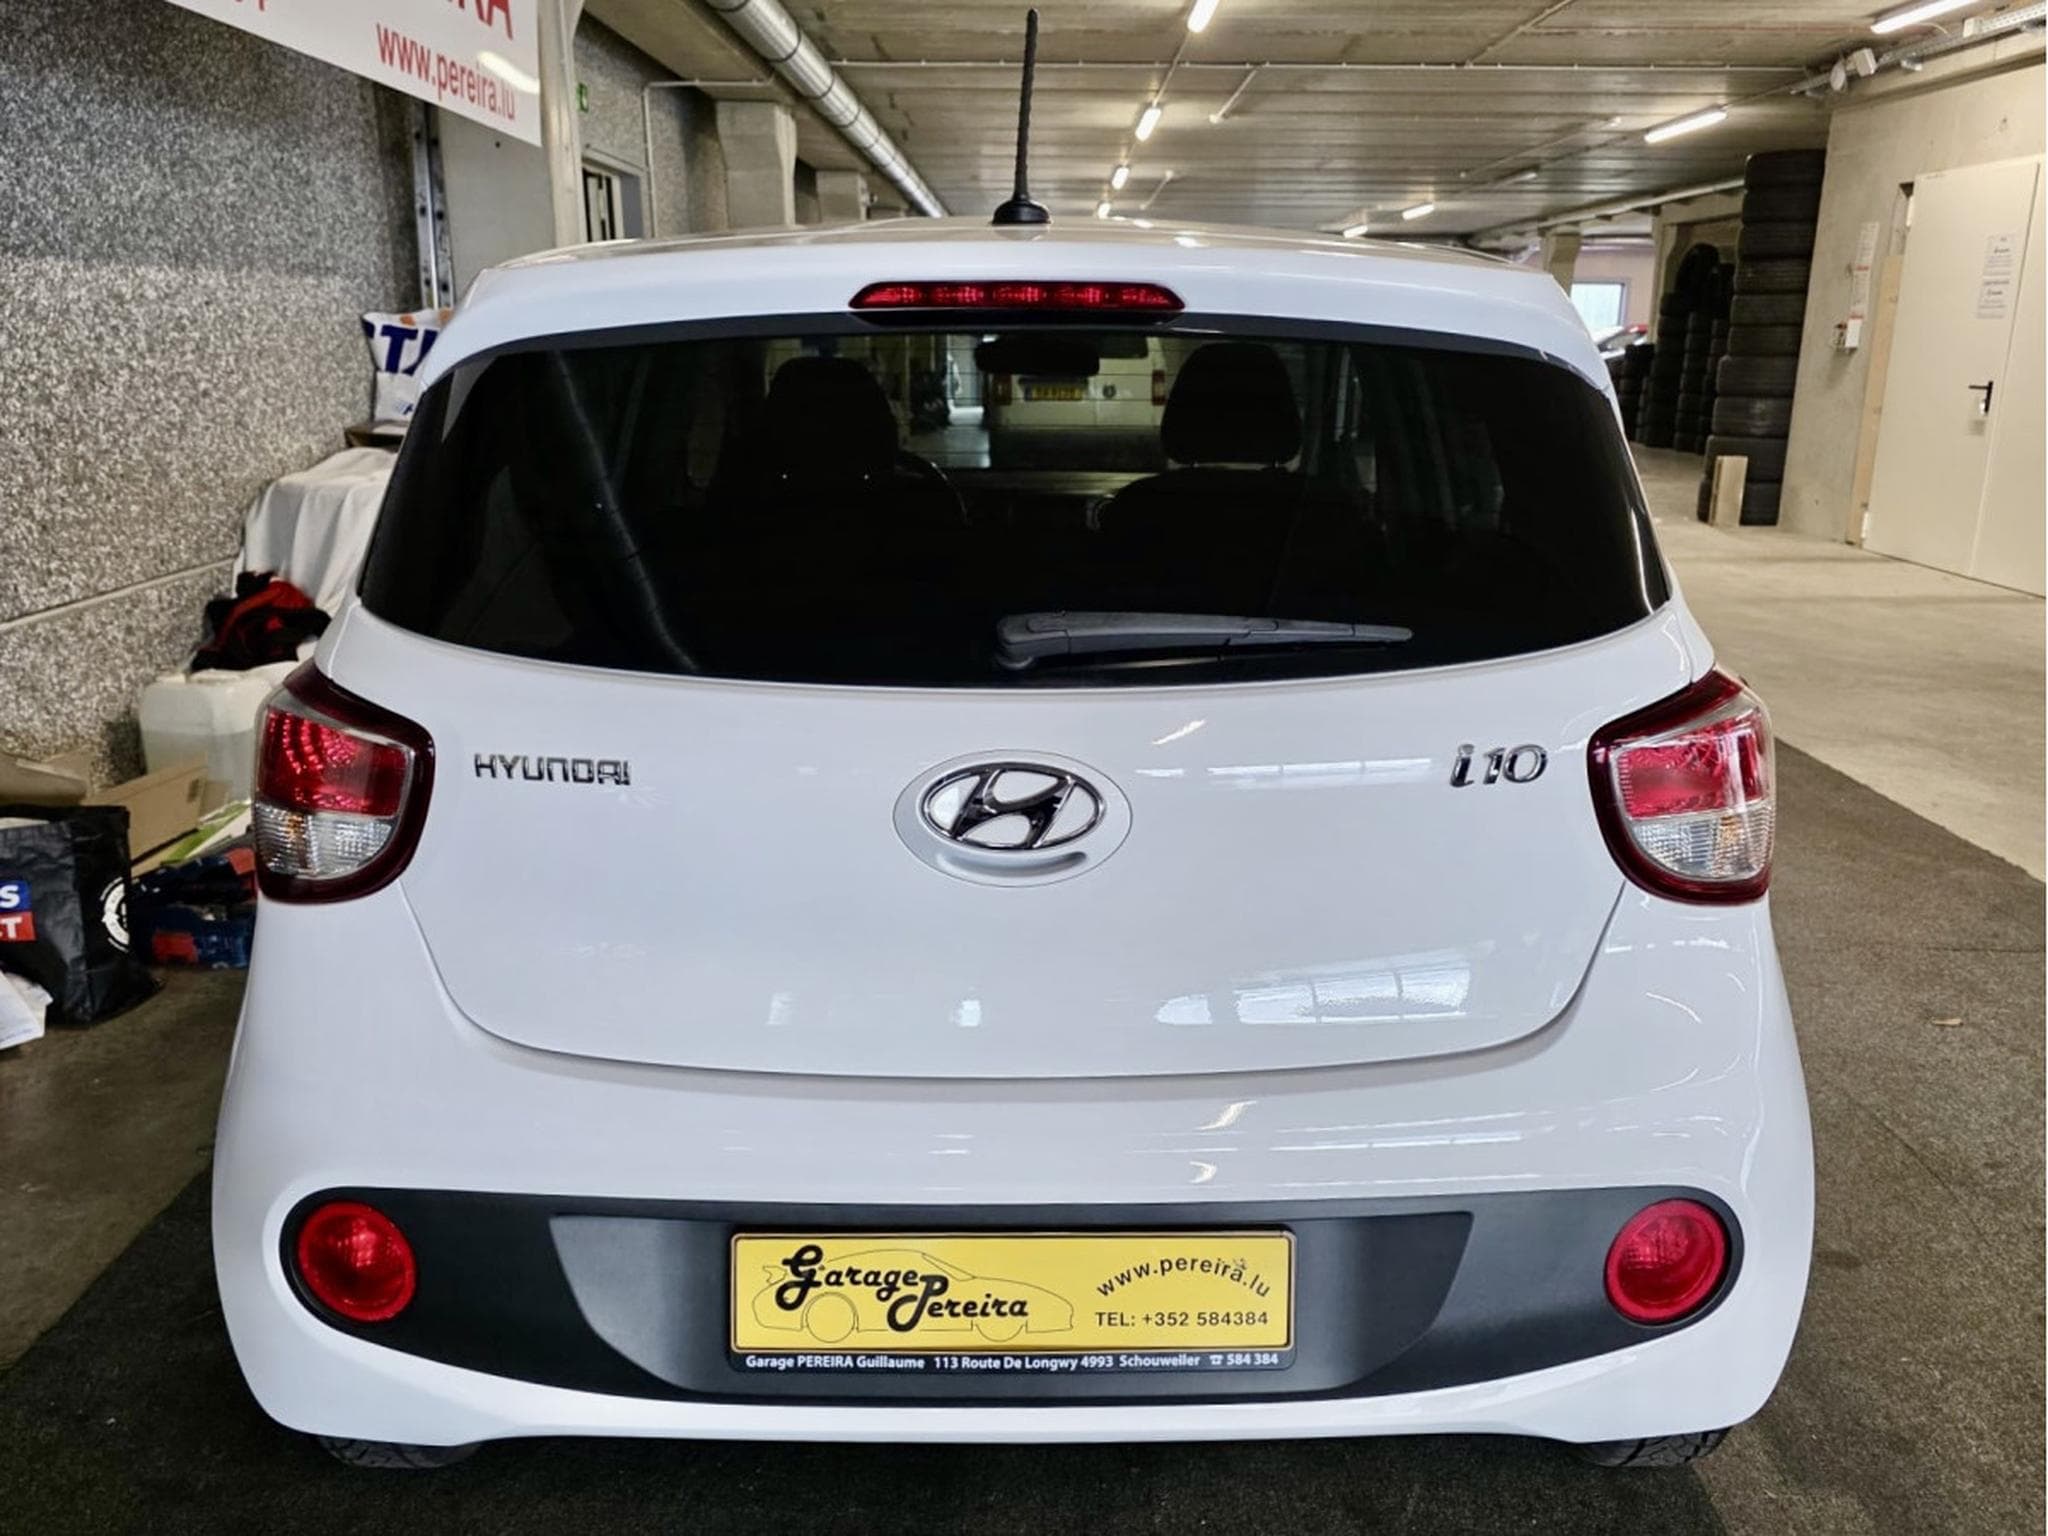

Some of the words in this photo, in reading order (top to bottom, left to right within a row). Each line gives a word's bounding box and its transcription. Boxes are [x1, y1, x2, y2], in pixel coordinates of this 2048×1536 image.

[376, 22, 516, 120] www.pereira.lu
[474, 753, 630, 785] HYUNDAI
[775, 1244, 919, 1311] Garage
[1097, 1257, 1271, 1298] www.pereira.lu
[886, 1274, 1029, 1332] Pereira
[1095, 1311, 1136, 1327] TEL:
[1142, 1311, 1190, 1327] +352
[1196, 1310, 1269, 1326] 584384
[746, 1355, 794, 1370] Garage
[797, 1356, 854, 1369] PEREIRA
[856, 1355, 926, 1369] Guillaume
[934, 1357, 958, 1369] 113
[962, 1357, 1001, 1369] Route
[1004, 1357, 1022, 1369] De
[1025, 1356, 1077, 1371] Longwy
[1081, 1355, 1114, 1368] 4993
[1119, 1354, 1201, 1367] Schouweiler
[1227, 1353, 1251, 1366] 584
[1254, 1353, 1279, 1366] 384
